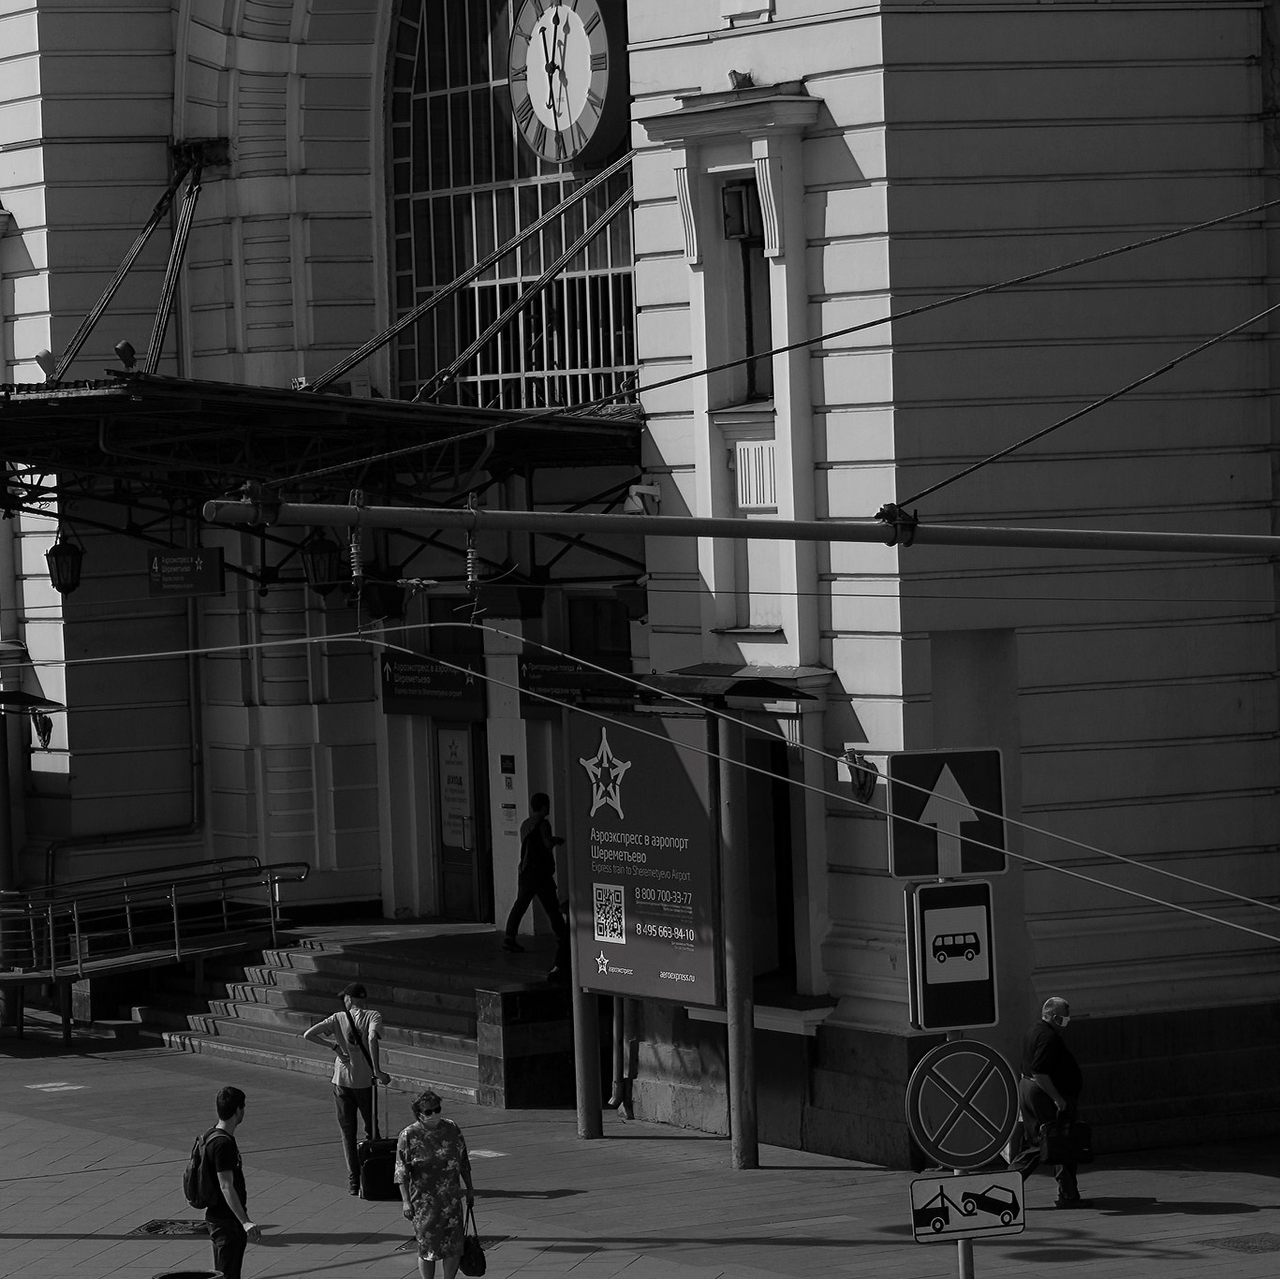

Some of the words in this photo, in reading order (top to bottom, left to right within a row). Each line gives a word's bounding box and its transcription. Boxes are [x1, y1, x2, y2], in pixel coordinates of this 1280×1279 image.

[152, 556, 158, 572] 4
[446, 774, 462, 787] ВХОД
[590, 827, 643, 847] Аэроэкспресс
[644, 835, 650, 846] в
[651, 835, 689, 852] аэропорт
[591, 845, 647, 863] Шереметьево
[591, 861, 612, 874] Express
[613, 863, 624, 875] train
[626, 865, 632, 875] to
[632, 865, 671, 880] Sheremetyevo
[671, 869, 690, 882] Airport
[634, 886, 640, 899] 8
[641, 887, 656, 901] 800
[657, 889, 692, 905] 700-33-77
[635, 922, 641, 936] 8
[642, 923, 657, 937] 495
[658, 925, 695, 941] 663-84-10
[659, 970, 696, 983] aeroexpress.ru
